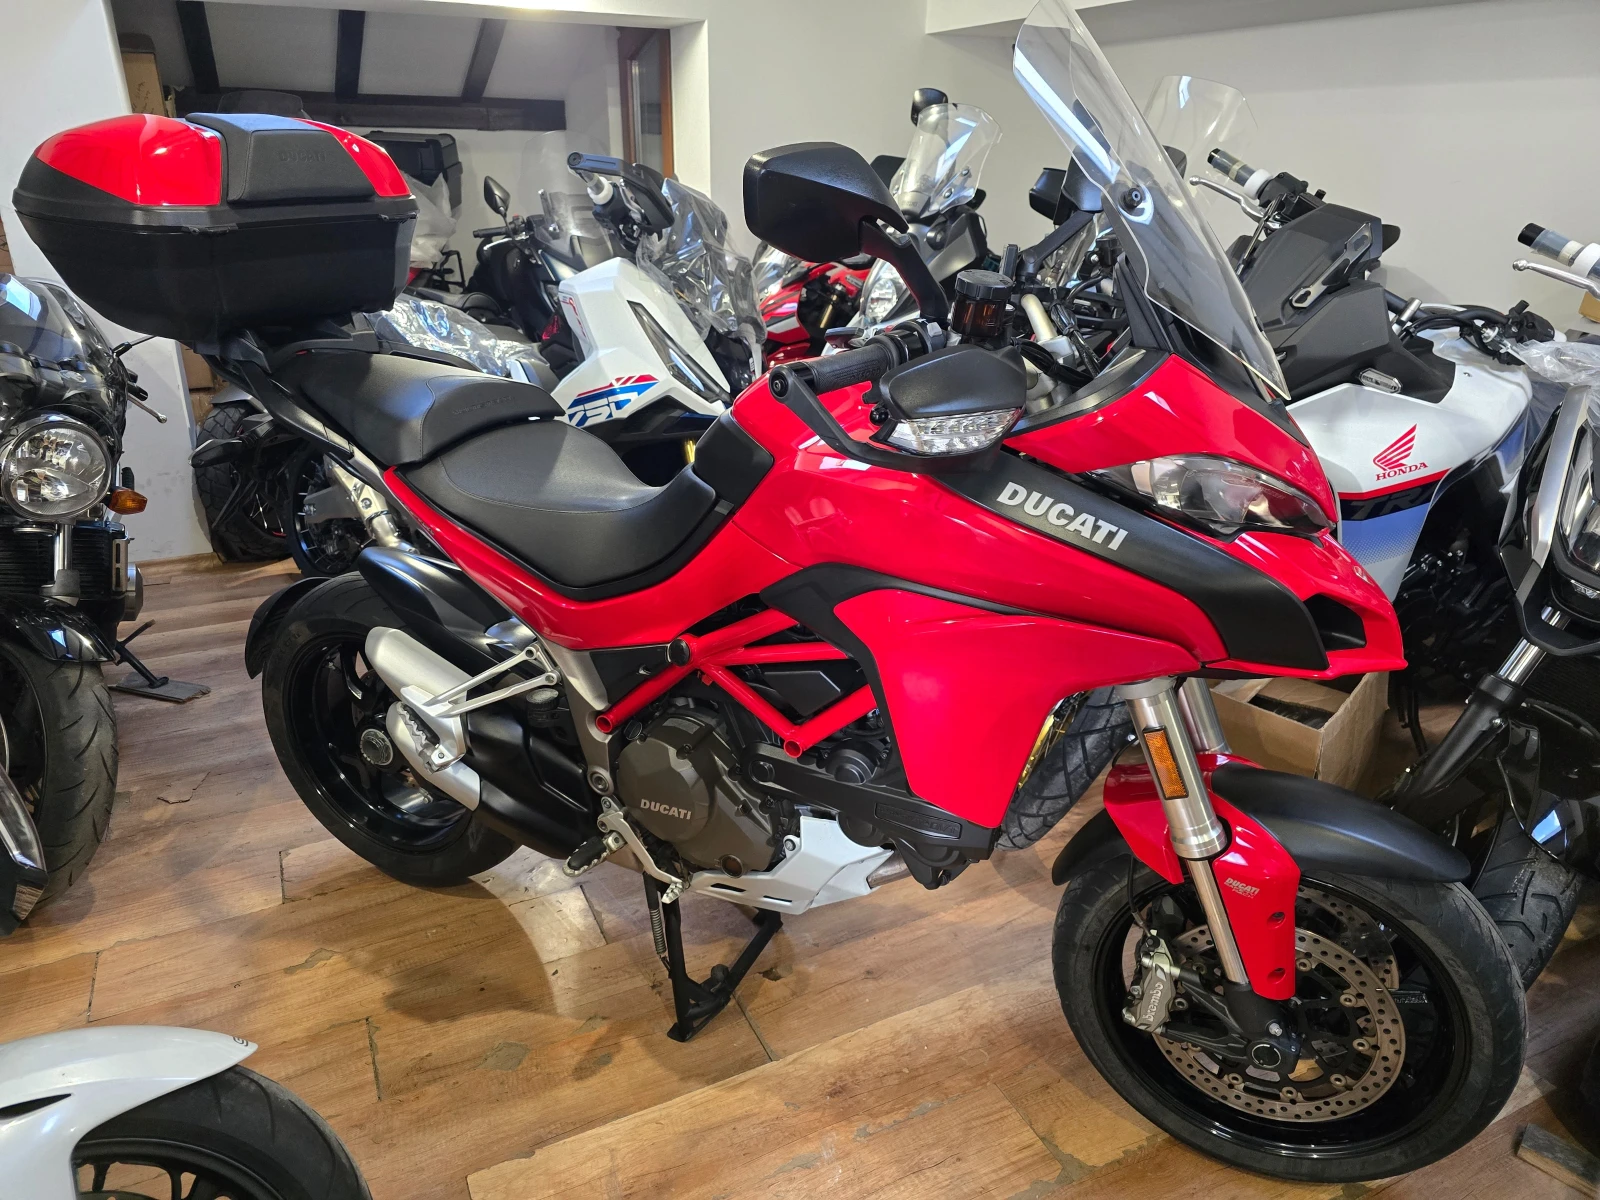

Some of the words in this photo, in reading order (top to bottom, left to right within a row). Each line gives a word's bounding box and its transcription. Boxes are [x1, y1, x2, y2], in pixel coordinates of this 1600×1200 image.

[1376, 462, 1428, 481] HONDA
[996, 481, 1129, 551] DUCATI
[640, 798, 692, 820] DUCATI
[1225, 877, 1260, 896] DUCATI
[1142, 981, 1164, 1022] brembo
